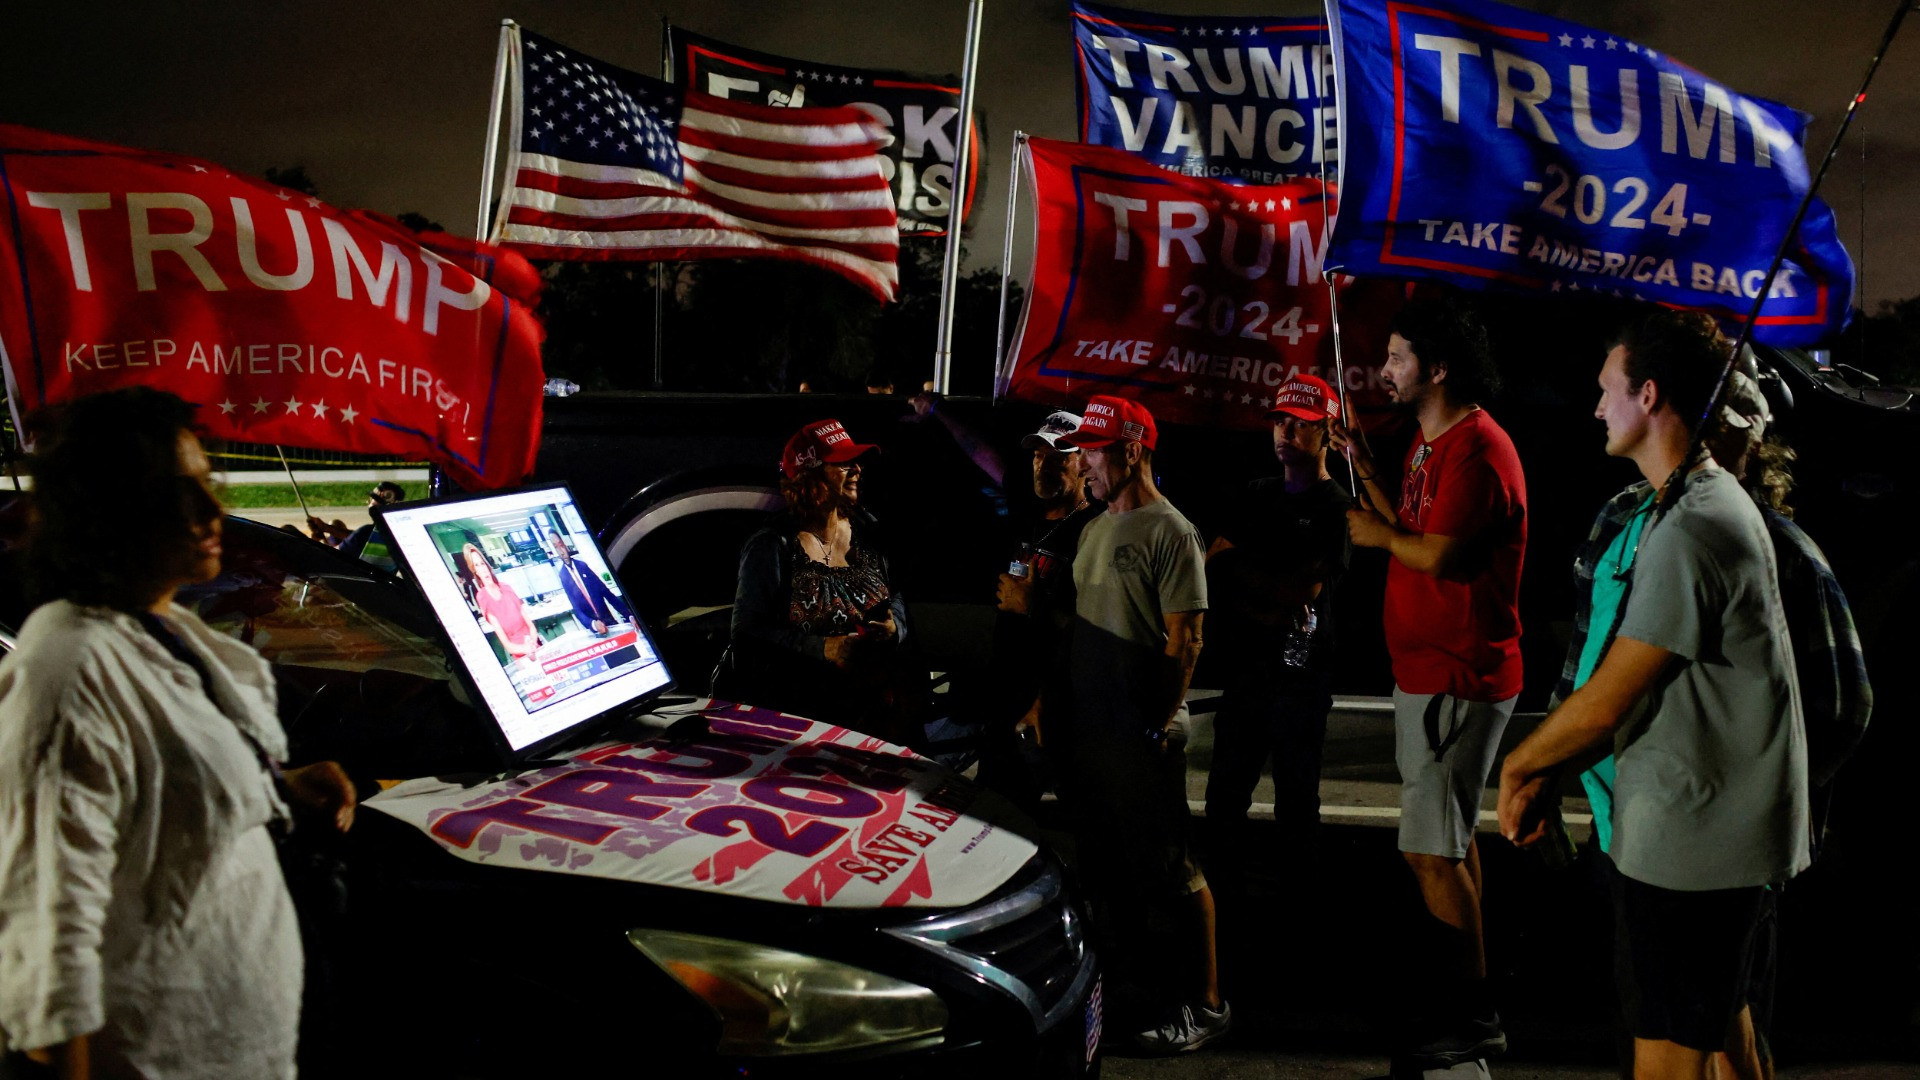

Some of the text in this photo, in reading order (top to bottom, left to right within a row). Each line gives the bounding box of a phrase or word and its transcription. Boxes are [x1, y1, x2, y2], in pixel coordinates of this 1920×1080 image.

[1109, 95, 1340, 165] VANCE
[1415, 33, 1796, 169] TRUMP
[1523, 162, 1712, 237] -2024-
[25, 190, 492, 337] TRUMP
[1094, 191, 1356, 288] TRUM
[1418, 218, 1800, 300] TAKE AMERICA BACK
[1161, 284, 1320, 346] -2024-
[64, 338, 178, 373] KEEP
[186, 339, 371, 389] AMERICA
[1072, 339, 1154, 366] TAKE
[815, 424, 836, 437] MAKE
[839, 823, 937, 885] SAVE
